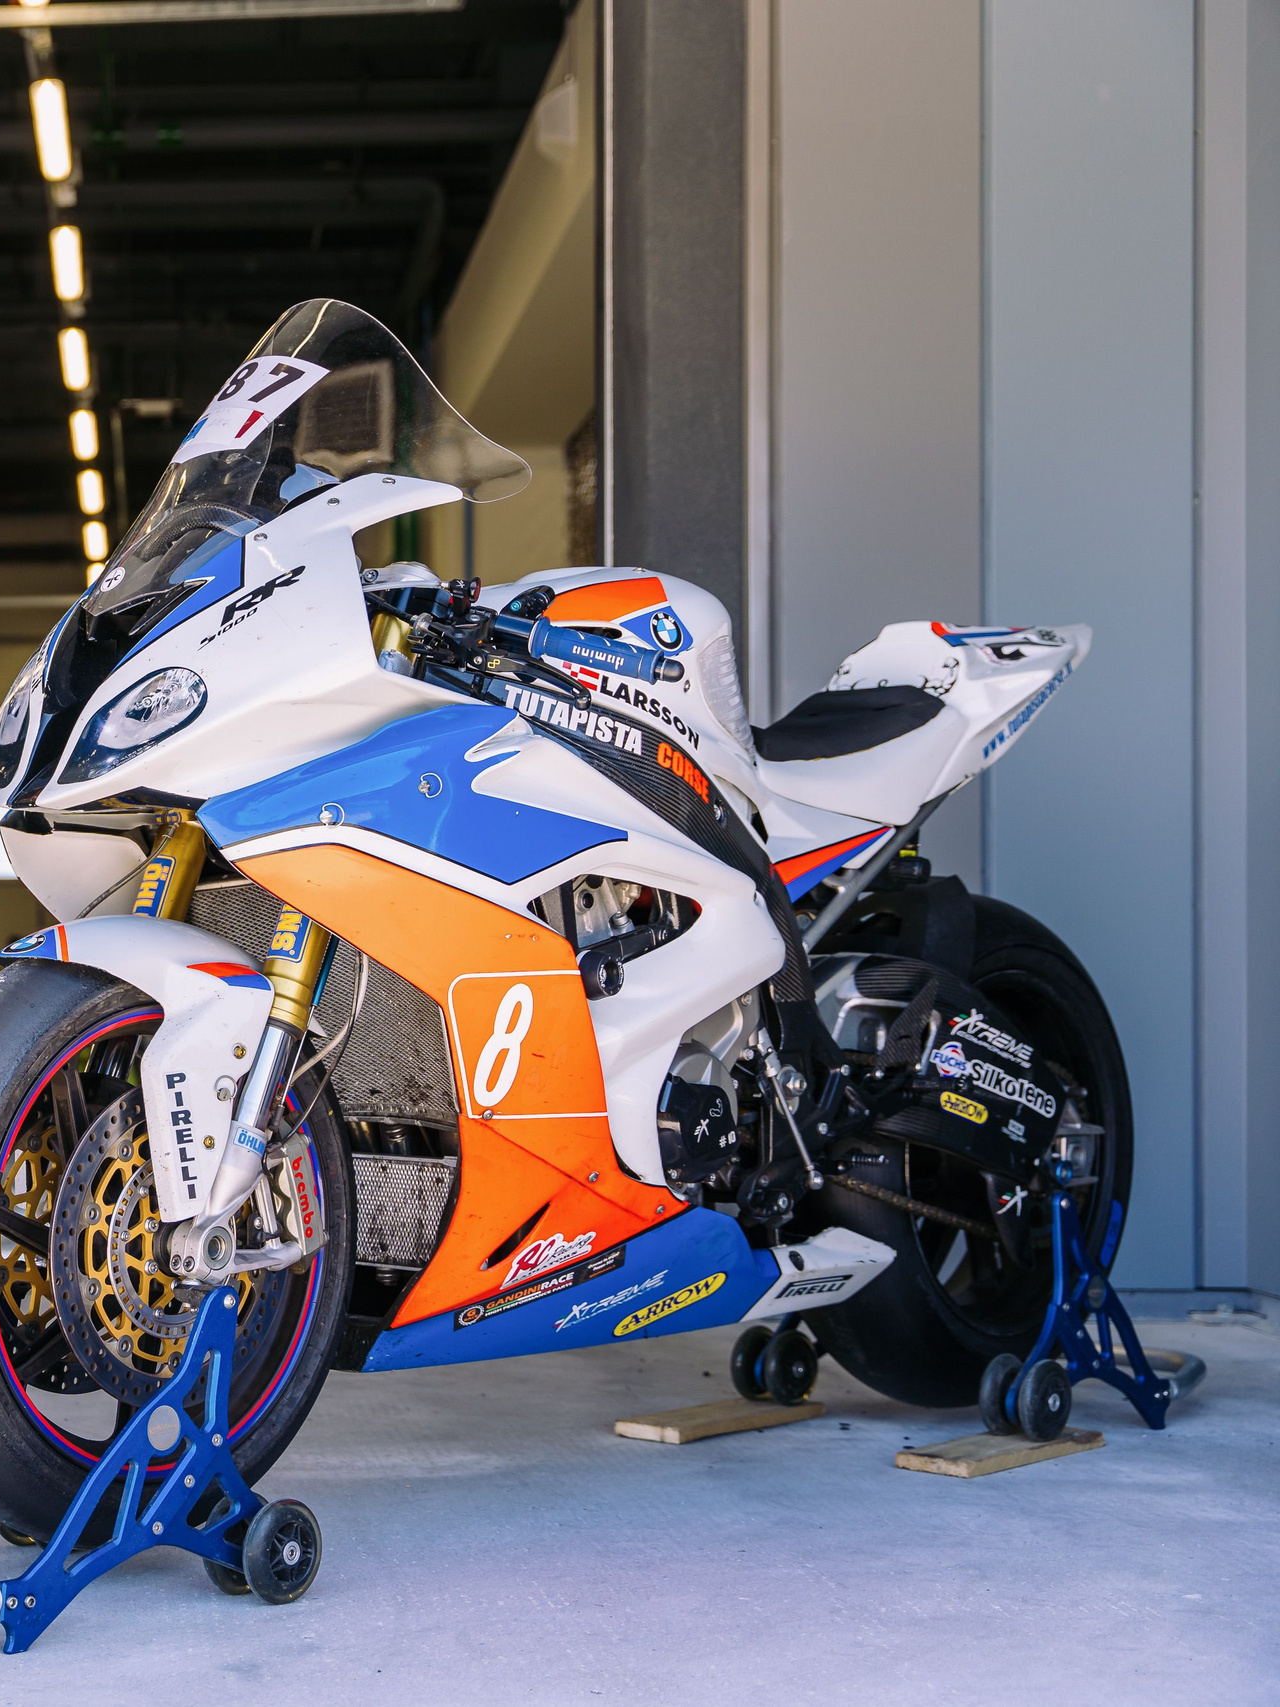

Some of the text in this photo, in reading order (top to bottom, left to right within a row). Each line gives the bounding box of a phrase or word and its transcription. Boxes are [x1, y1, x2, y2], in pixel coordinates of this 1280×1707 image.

[217, 361, 306, 403] 87
[220, 565, 306, 628] RR
[572, 645, 625, 670] domino
[600, 675, 700, 751] LARSSON
[504, 684, 710, 804] TUTAPISTA CORSE
[133, 863, 169, 916] ÖHL
[473, 983, 533, 1107] 8
[950, 1008, 1034, 1060] XTREME
[933, 1052, 1053, 1115] FUCHS Silkolene
[943, 1095, 986, 1119] ARROW
[166, 1072, 197, 1199] PIRELLI
[292, 1156, 314, 1238] brembo
[506, 1238, 556, 1284] RC
[774, 1274, 854, 1300] PIRELLI
[484, 1306, 502, 1317] HIGH
[552, 1282, 573, 1293] PARTS
[555, 1269, 669, 1333] XTREME
[621, 1275, 720, 1330] ARROW
